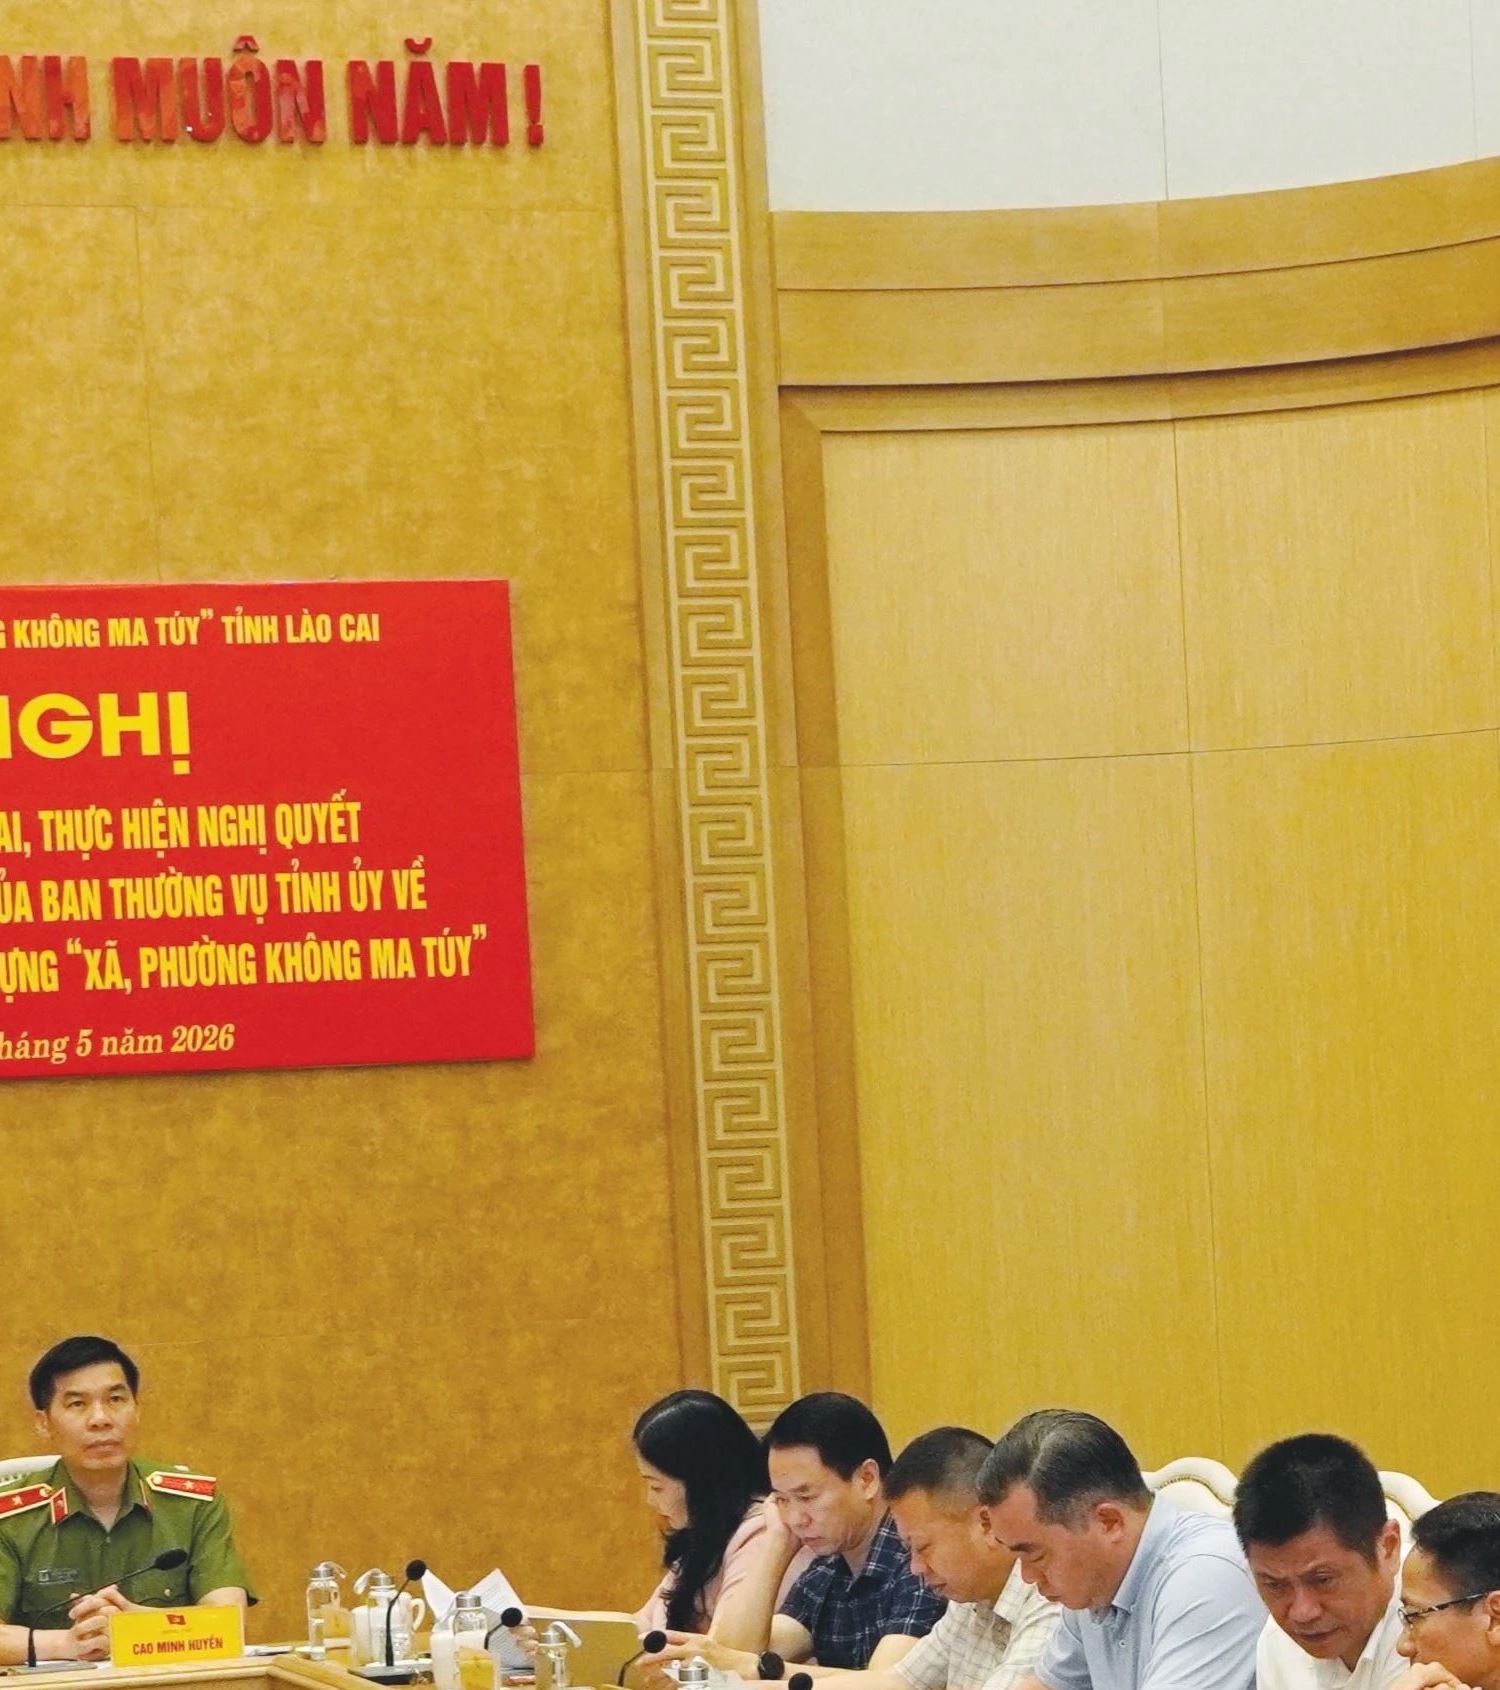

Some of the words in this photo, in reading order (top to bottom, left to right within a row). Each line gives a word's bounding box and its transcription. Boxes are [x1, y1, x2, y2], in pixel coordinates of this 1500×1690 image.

[112, 35, 326, 144] MUÔN
[346, 36, 509, 146] NĂM
[13, 613, 100, 648] KHÔNG
[107, 617, 149, 647] MA
[154, 608, 214, 646] TÚY”
[221, 606, 279, 644] TỈNH
[285, 608, 332, 643] LÀO
[339, 613, 380, 642] CAI
[38, 805, 113, 861] THỰC
[121, 798, 189, 858] HIỆN
[197, 804, 267, 854] NGHỊ
[275, 789, 361, 849] QUYẾT
[40, 879, 102, 922] BAN
[108, 866, 224, 919] THƯỜNG
[230, 874, 268, 924] VỤ
[275, 858, 341, 914] TỈNH
[348, 856, 383, 912] ỦY
[391, 855, 427, 910] VỀ
[67, 938, 132, 992] “XÃ,
[139, 935, 257, 988] PHƯỜNG
[265, 932, 362, 983] KHÔNG
[369, 938, 416, 979] MA
[421, 924, 486, 977] TÚY”
[76, 1029, 92, 1056] 5
[101, 1029, 163, 1056] năm
[171, 1024, 235, 1052] 2026
[133, 1643, 153, 1655] CAO
[157, 1640, 185, 1653] MINH
